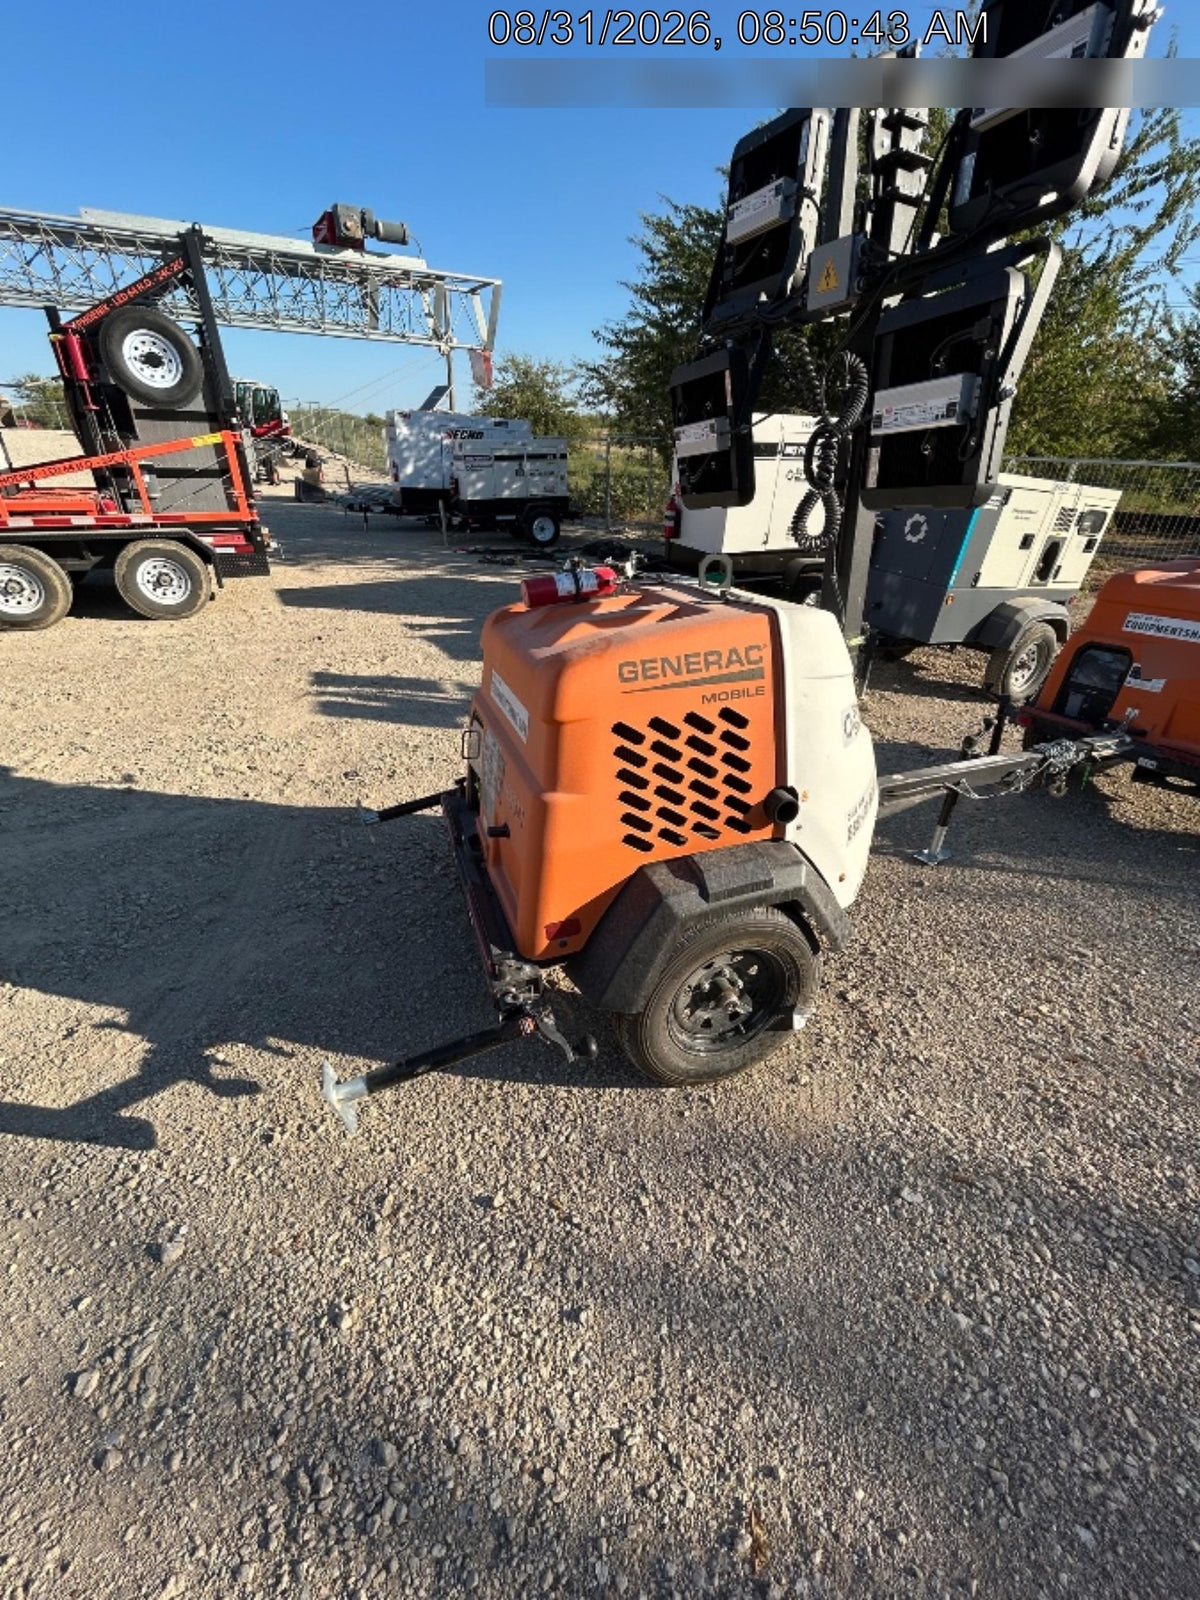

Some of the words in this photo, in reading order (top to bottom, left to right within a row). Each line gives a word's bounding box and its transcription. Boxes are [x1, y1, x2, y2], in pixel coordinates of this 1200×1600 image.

[1125, 620, 1200, 640] EQUIPMENTSH
[618, 644, 764, 683] GENERAC
[701, 686, 765, 705] MOBILE
